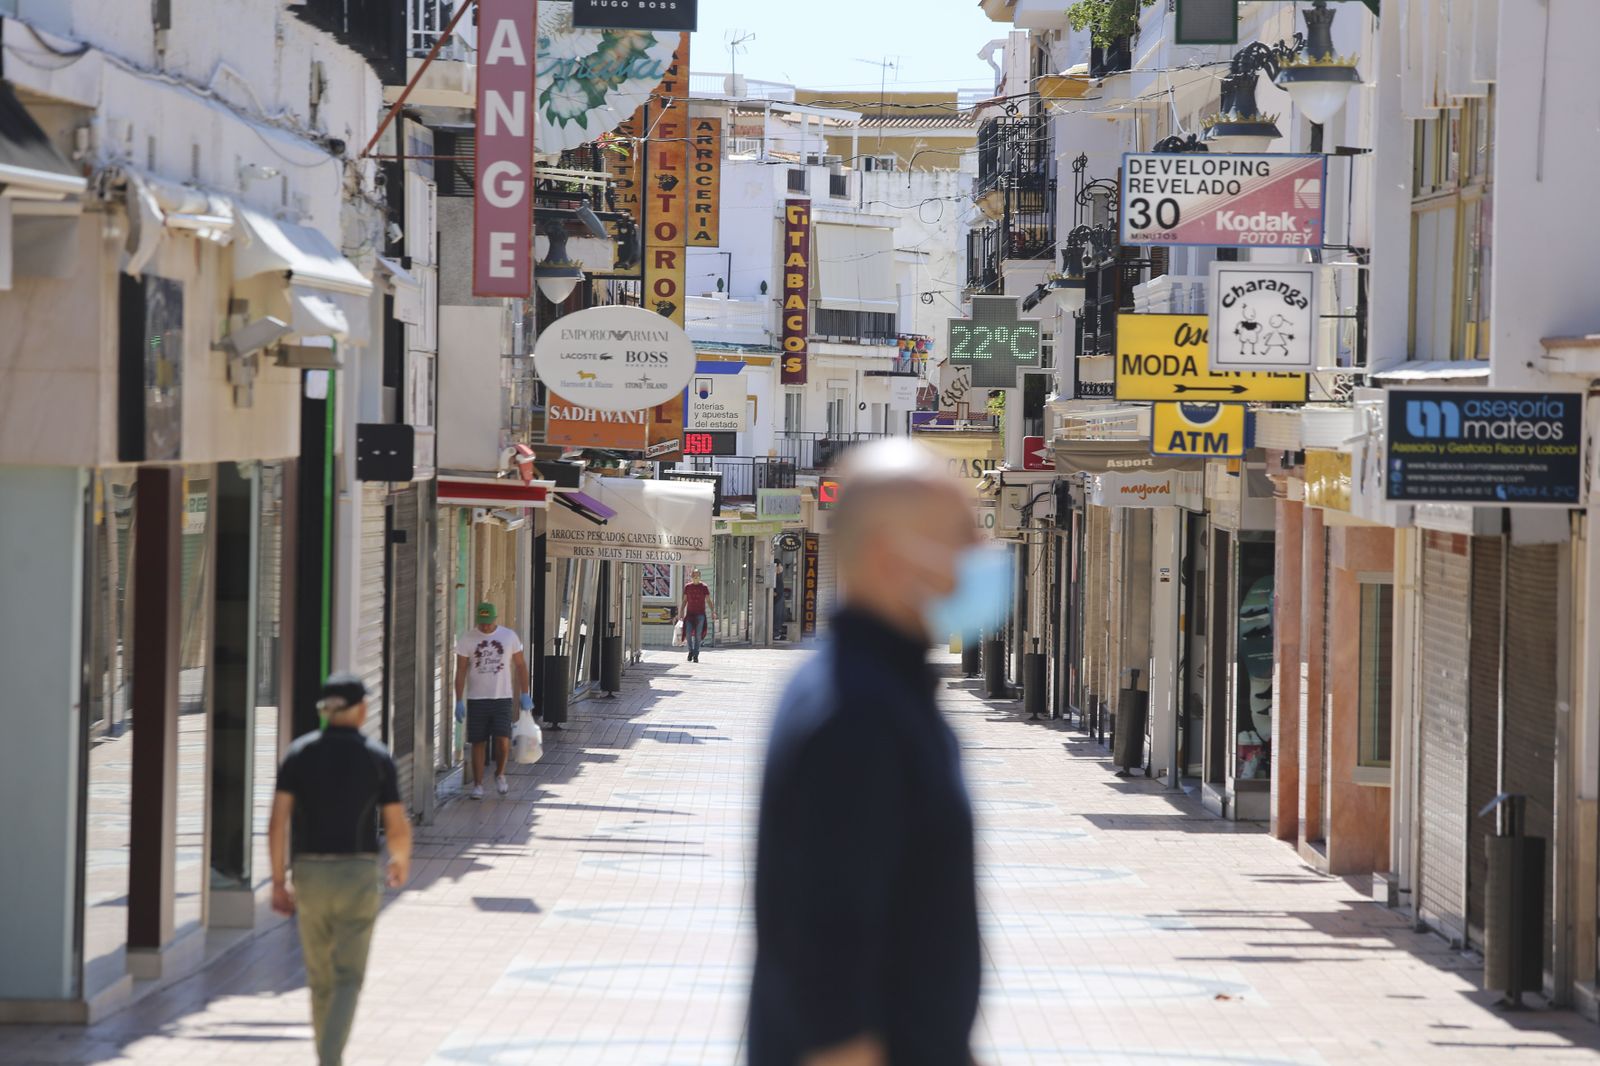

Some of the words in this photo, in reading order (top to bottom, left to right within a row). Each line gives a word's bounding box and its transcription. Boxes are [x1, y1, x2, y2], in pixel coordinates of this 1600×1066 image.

[590, 0, 629, 8] HUGO
[638, 2, 677, 10] BOSS
[482, 19, 527, 279] ANGE
[1128, 159, 1271, 177] DEVELOPING
[694, 121, 715, 241] ARROCERIA
[1128, 178, 1242, 196] REVELADO
[1128, 197, 1181, 231] 30
[1215, 210, 1297, 233] Kodak
[654, 193, 678, 298] TORO
[1130, 232, 1178, 241] MINUTOS
[1237, 232, 1279, 245] FOTO
[1281, 233, 1313, 245] REY
[784, 231, 808, 374] TABACOS
[1221, 279, 1310, 311] Charanga
[560, 328, 612, 341] EMPORIO
[627, 330, 669, 342] ARMANI
[560, 353, 598, 361] LACOSTE
[625, 350, 669, 364] BOSS
[1121, 354, 1199, 377] MODA
[694, 412, 700, 420] y
[702, 411, 740, 420] apuestas
[1463, 395, 1565, 419] asesoría
[695, 420, 708, 428] del
[710, 421, 739, 429] estado
[1463, 417, 1565, 441] mateos
[1168, 430, 1229, 454] ATM
[1106, 457, 1154, 469] Asport
[1120, 479, 1171, 501] mayoral
[550, 529, 586, 541] ARROCES
[586, 531, 626, 543] PESCADOS
[627, 533, 656, 544] CARNES
[573, 546, 595, 557] RICES
[598, 548, 623, 558] MEATS
[625, 549, 642, 560] FISH
[804, 557, 816, 633] TABACOS
